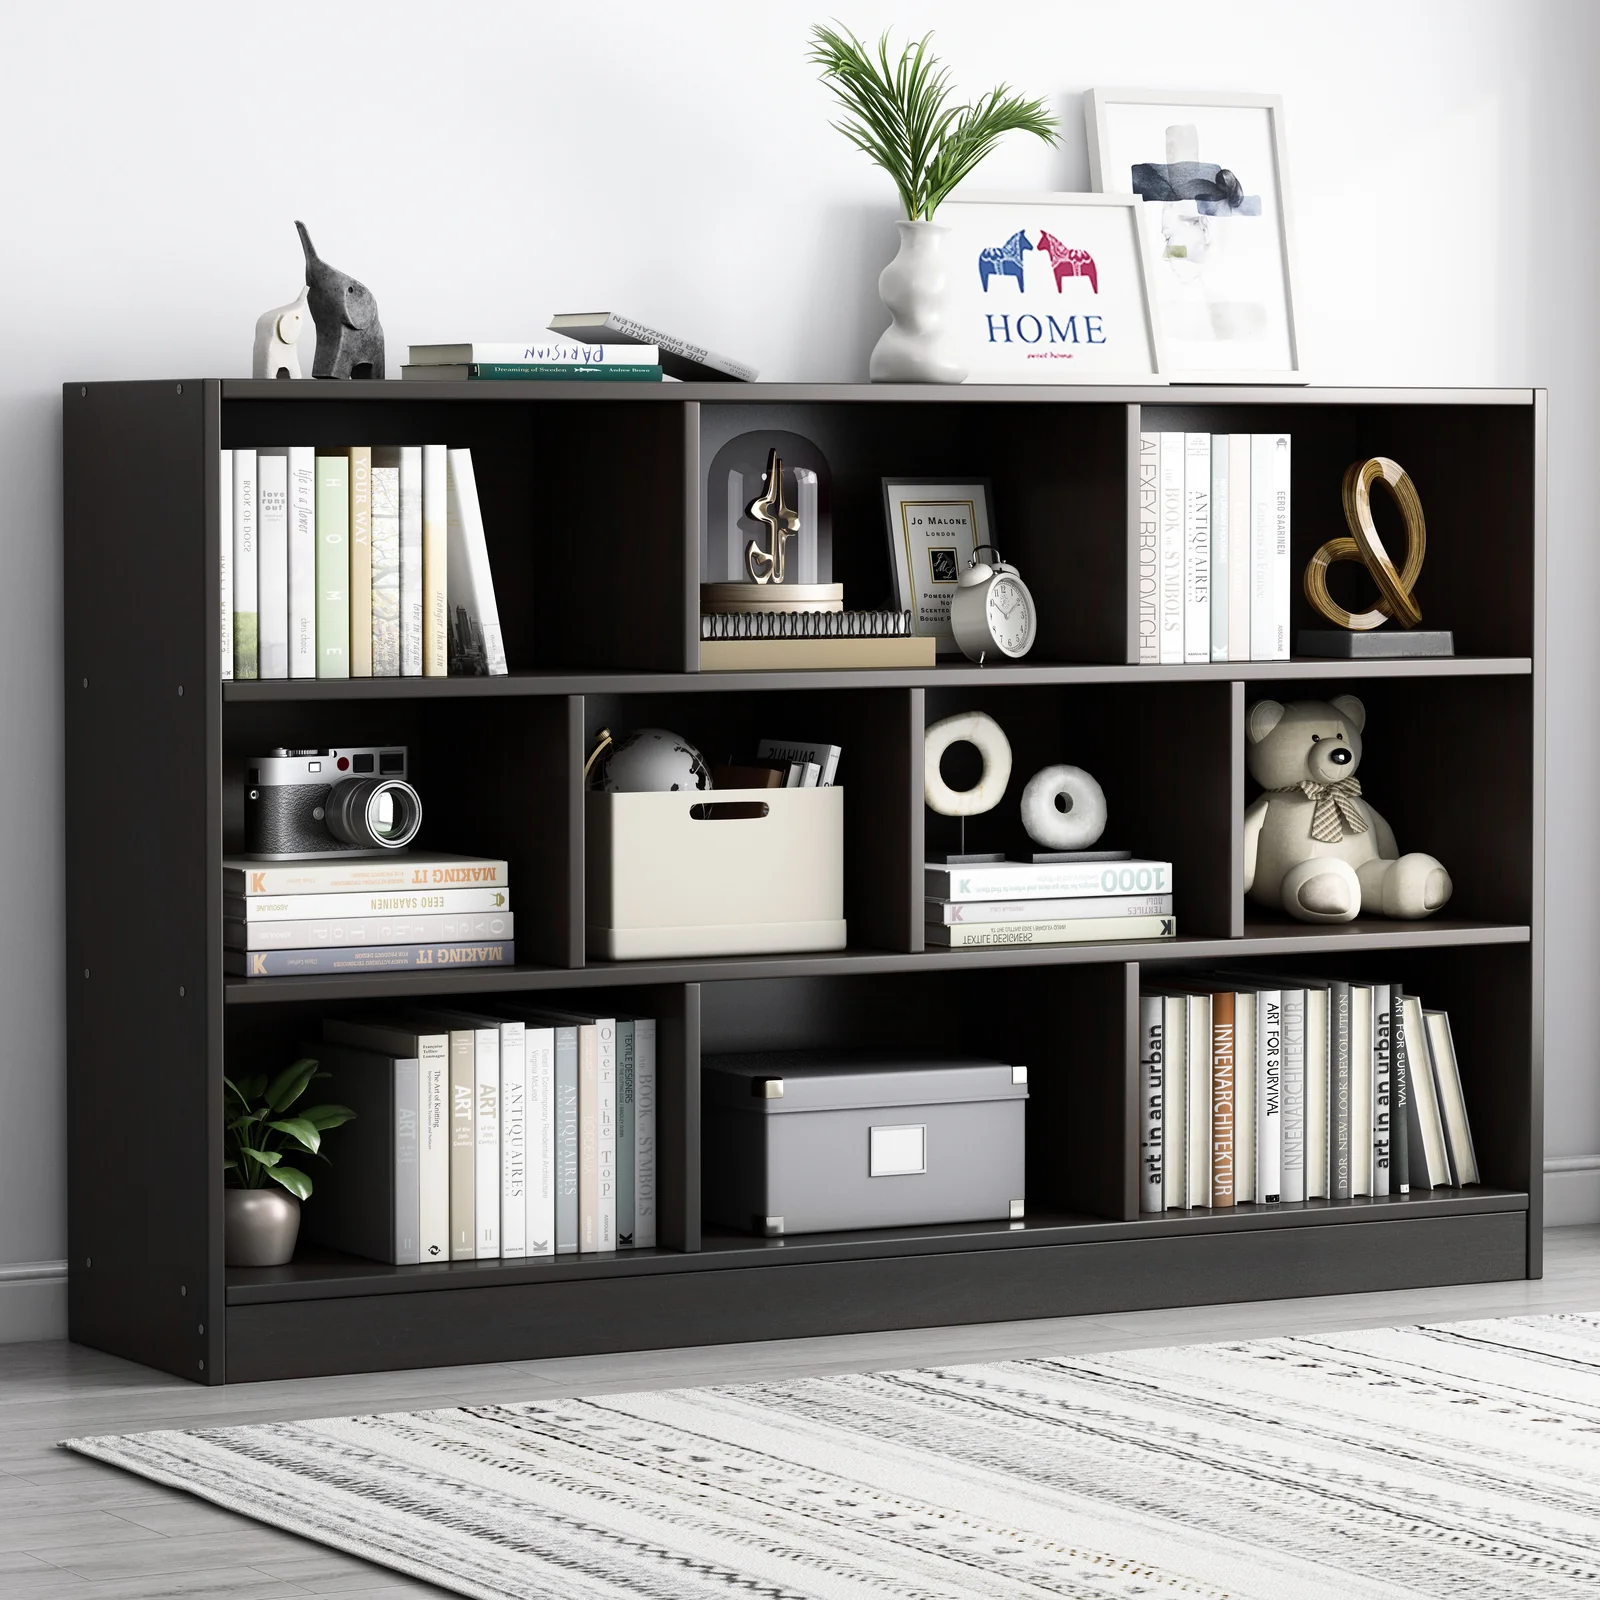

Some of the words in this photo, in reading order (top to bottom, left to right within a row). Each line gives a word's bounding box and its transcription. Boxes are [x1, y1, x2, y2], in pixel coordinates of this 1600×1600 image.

[612, 315, 691, 349] PRIMZAHLEN
[616, 326, 687, 359] EINSAMKEIT
[985, 313, 1107, 344] HOME
[524, 344, 604, 364] PARISIAN
[686, 351, 705, 364] DIE
[690, 345, 709, 357] DER
[294, 469, 313, 487] life
[355, 457, 367, 504] YOUR
[263, 490, 285, 498] love
[1277, 491, 1286, 511] EERO
[911, 517, 923, 526] JO
[928, 517, 967, 525] MALONE
[1165, 488, 1181, 533] BOOK
[355, 507, 368, 546] WAY
[1277, 514, 1286, 554] SAARINEN
[1192, 491, 1208, 604] ANTIQUAIRES
[325, 478, 342, 656] HOME
[1001, 585, 1006, 593] 12
[1164, 551, 1180, 632] SYMBOLS
[411, 869, 429, 884] IT
[432, 867, 497, 883] MAKING
[1101, 867, 1166, 892] 1000
[371, 898, 417, 910] SAARINEN
[421, 897, 444, 907] EERO
[1160, 919, 1173, 935] K
[416, 949, 433, 964] IT
[437, 946, 503, 963] MAKING
[1267, 1003, 1279, 1024] ART
[624, 1033, 632, 1063] TEXTILE
[1267, 1029, 1279, 1056] FOR
[1338, 994, 1348, 1076] REVOLUTION
[1374, 1012, 1389, 1074] urban
[530, 1050, 538, 1074] Virginia
[541, 1049, 549, 1067] Detail
[600, 1027, 612, 1082] Over
[1142, 1025, 1162, 1089] urban
[531, 1075, 539, 1101] McLeod
[540, 1077, 549, 1122] Contemporary
[624, 1064, 633, 1104] DESIGNERS
[639, 1074, 652, 1119] BOOK
[1266, 1060, 1279, 1116] SURVIVAL
[1284, 1002, 1303, 1171] INNENARCHITEKTUR
[1338, 1078, 1347, 1115] LOOK
[1379, 1080, 1389, 1110] an
[433, 1102, 441, 1128] Knitting
[454, 1085, 472, 1120] ART
[479, 1084, 496, 1118] ART
[1148, 1094, 1161, 1124] an
[1214, 1023, 1233, 1196] INNENARCHITEKTUR
[399, 1108, 416, 1138] ART
[602, 1098, 612, 1137] the
[1338, 1118, 1347, 1148] NEW
[1373, 1113, 1390, 1132] in
[508, 1083, 523, 1197] ANTIQUAIRES
[541, 1124, 549, 1159] Residential
[562, 1084, 576, 1196] ANTIQUAIRES
[1143, 1127, 1162, 1147] in
[1146, 1153, 1162, 1185] art
[1375, 1139, 1389, 1169] art
[541, 1161, 549, 1199] Architecture
[601, 1150, 612, 1197] Top
[639, 1137, 652, 1216] SYMBOLS
